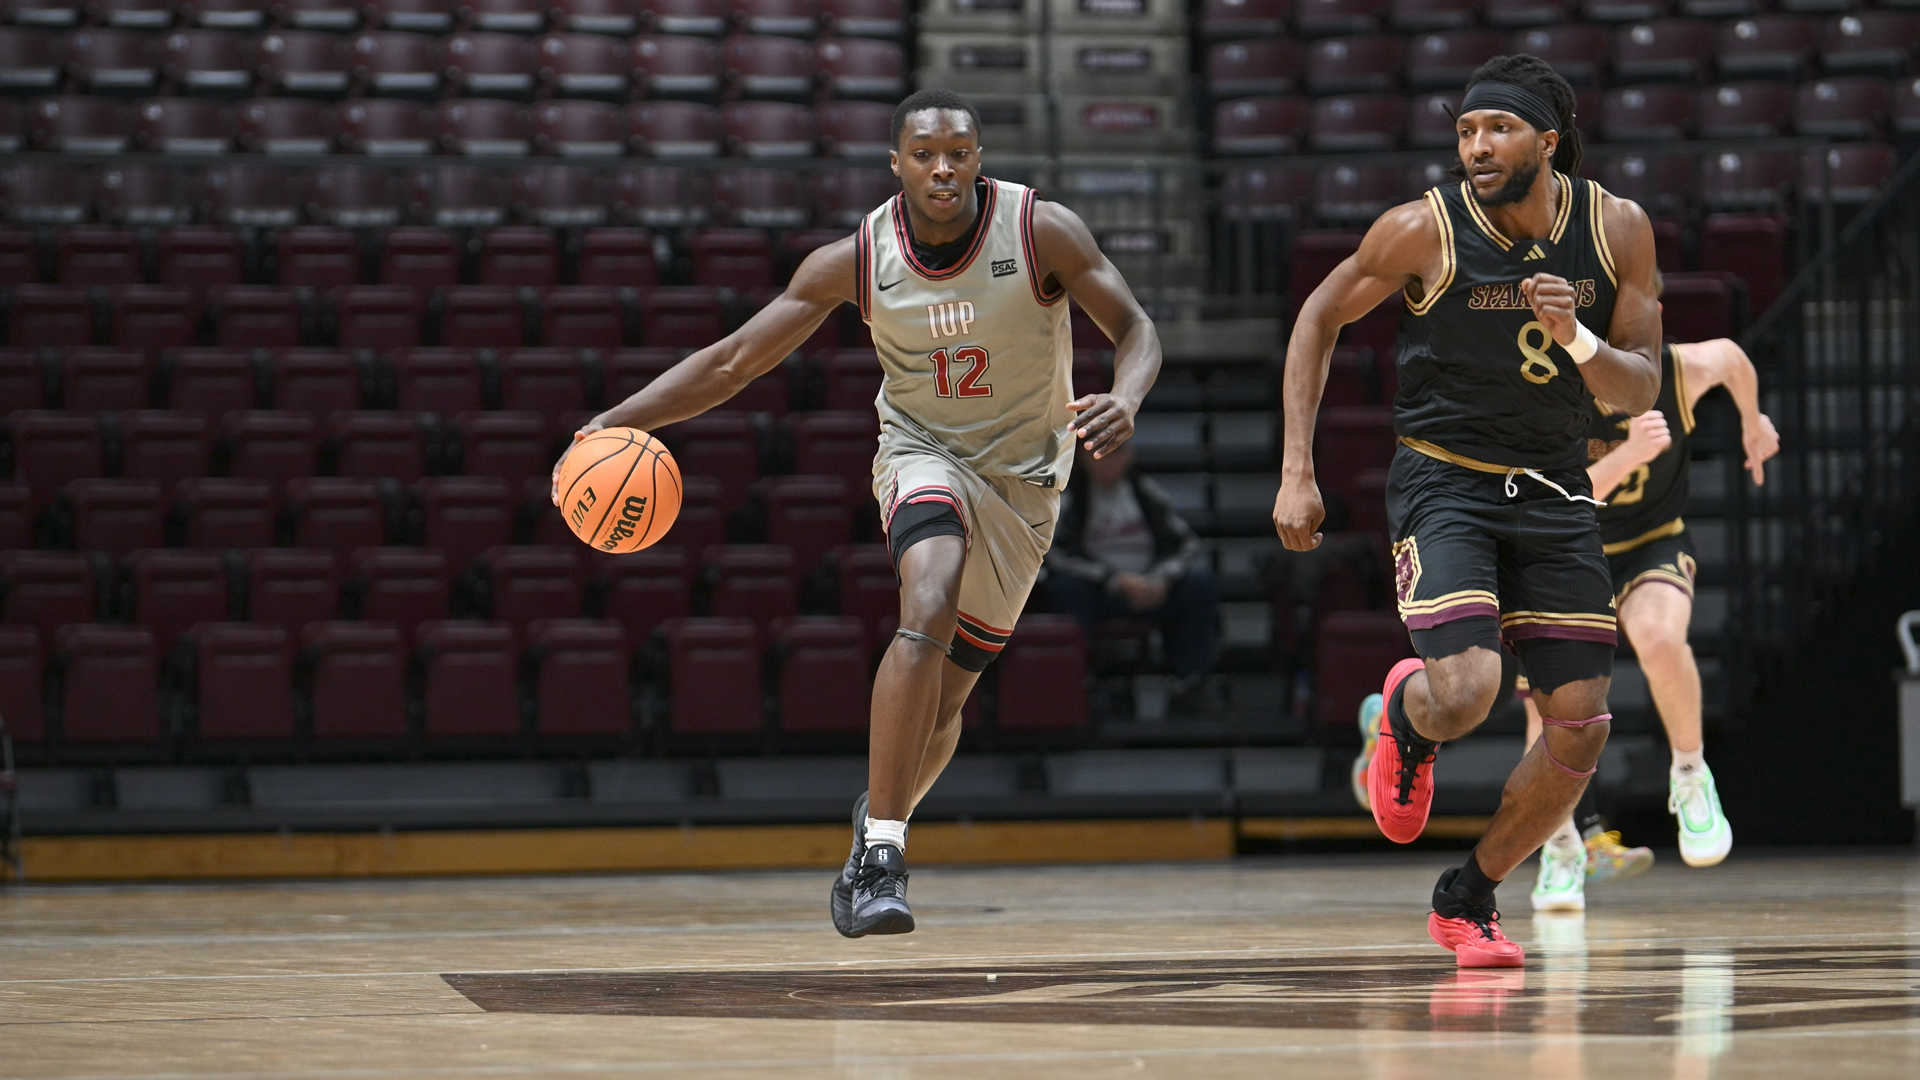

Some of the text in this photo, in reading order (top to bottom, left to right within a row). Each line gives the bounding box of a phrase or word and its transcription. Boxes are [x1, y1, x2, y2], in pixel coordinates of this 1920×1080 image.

[991, 261, 1018, 274] PSAC
[1469, 279, 1596, 309] SPARNS
[927, 301, 975, 339] IUP
[929, 346, 992, 398] 12
[1517, 320, 1559, 385] 8
[599, 496, 647, 551] Wilson
